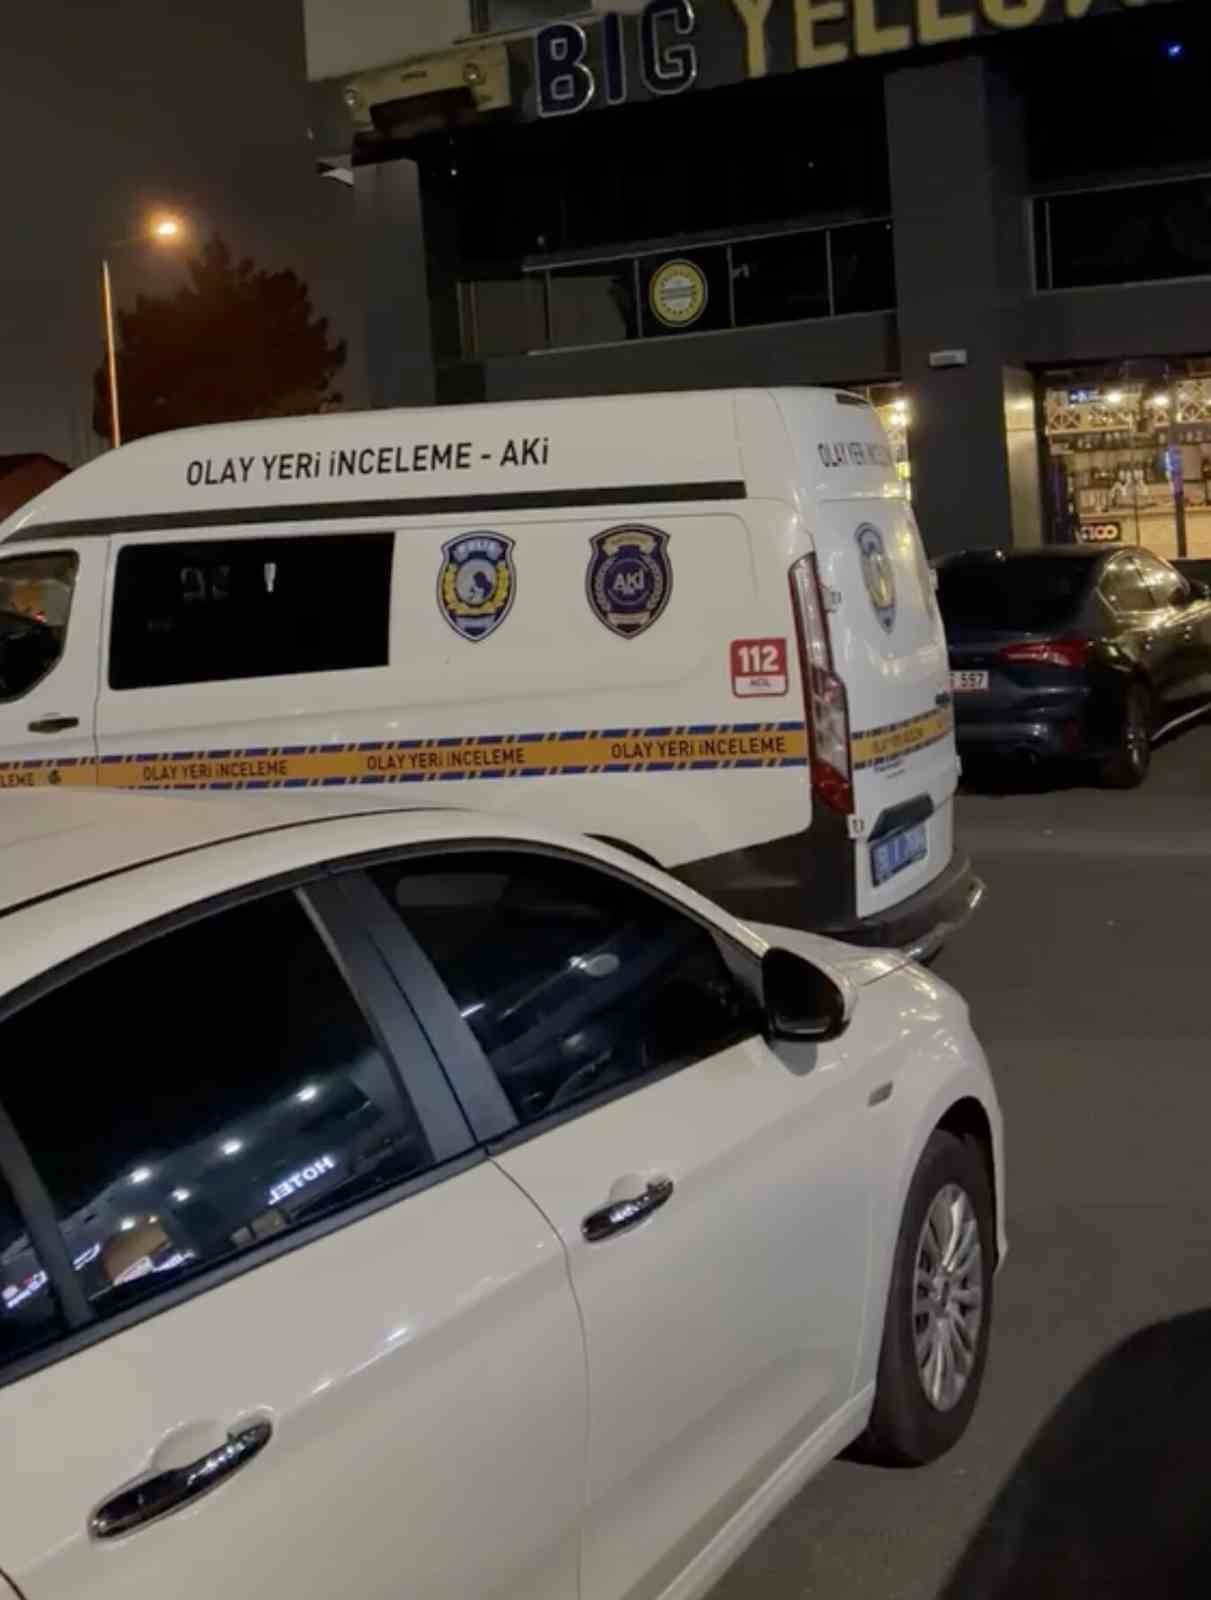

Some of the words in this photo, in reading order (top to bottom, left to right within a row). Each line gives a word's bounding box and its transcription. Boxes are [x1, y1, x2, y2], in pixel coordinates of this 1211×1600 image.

[533, 0, 697, 117] BIG
[186, 456, 255, 486] OLAY
[737, 645, 780, 673] 112
[366, 753, 406, 770] OLAY
[610, 742, 652, 759] OLAY
[143, 765, 177, 781] OLAY
